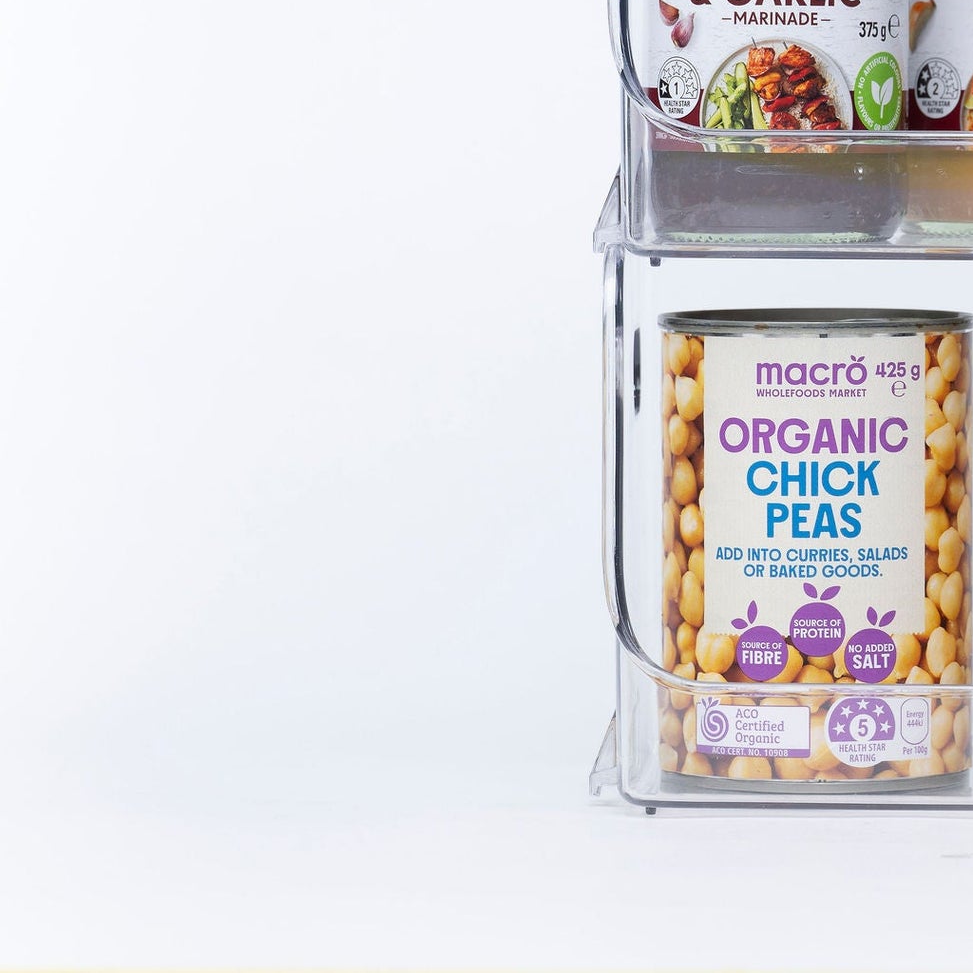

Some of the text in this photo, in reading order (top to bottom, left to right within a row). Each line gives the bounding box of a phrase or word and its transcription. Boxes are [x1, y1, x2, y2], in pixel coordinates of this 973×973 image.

[733, 11, 818, 26] MARINADE
[859, 21, 878, 38] 375
[880, 25, 887, 42] g
[933, 82, 939, 95] 2
[875, 362, 906, 378] 425
[911, 364, 920, 381] g
[756, 388, 867, 398] WHOLEFOODS MARKET
[719, 417, 909, 454] ORGANIC
[746, 460, 880, 497] CHICK
[766, 503, 862, 539] PEAS
[716, 547, 908, 563] ADD INTO CURRIES, SALADS
[743, 564, 883, 578] OR BAKED GOODS.
[793, 619, 841, 627] SOURCE OF
[793, 628, 841, 639] PROTEIN
[742, 641, 782, 650] SOURCE OF
[848, 643, 895, 653] NO ADDED
[742, 651, 782, 665] FIBRE
[852, 654, 890, 669] SALT
[735, 708, 759, 719] ACO
[906, 711, 924, 719] Energy
[735, 720, 785, 732] Certified
[858, 719, 868, 737] 5
[735, 732, 780, 746] Organic
[712, 746, 725, 755] ACO
[748, 748, 761, 756] NO.
[764, 749, 789, 757] 10908
[839, 743, 886, 752] HEALTH STAR
[903, 746, 928, 755] Per 100g
[849, 754, 876, 762] RATING
